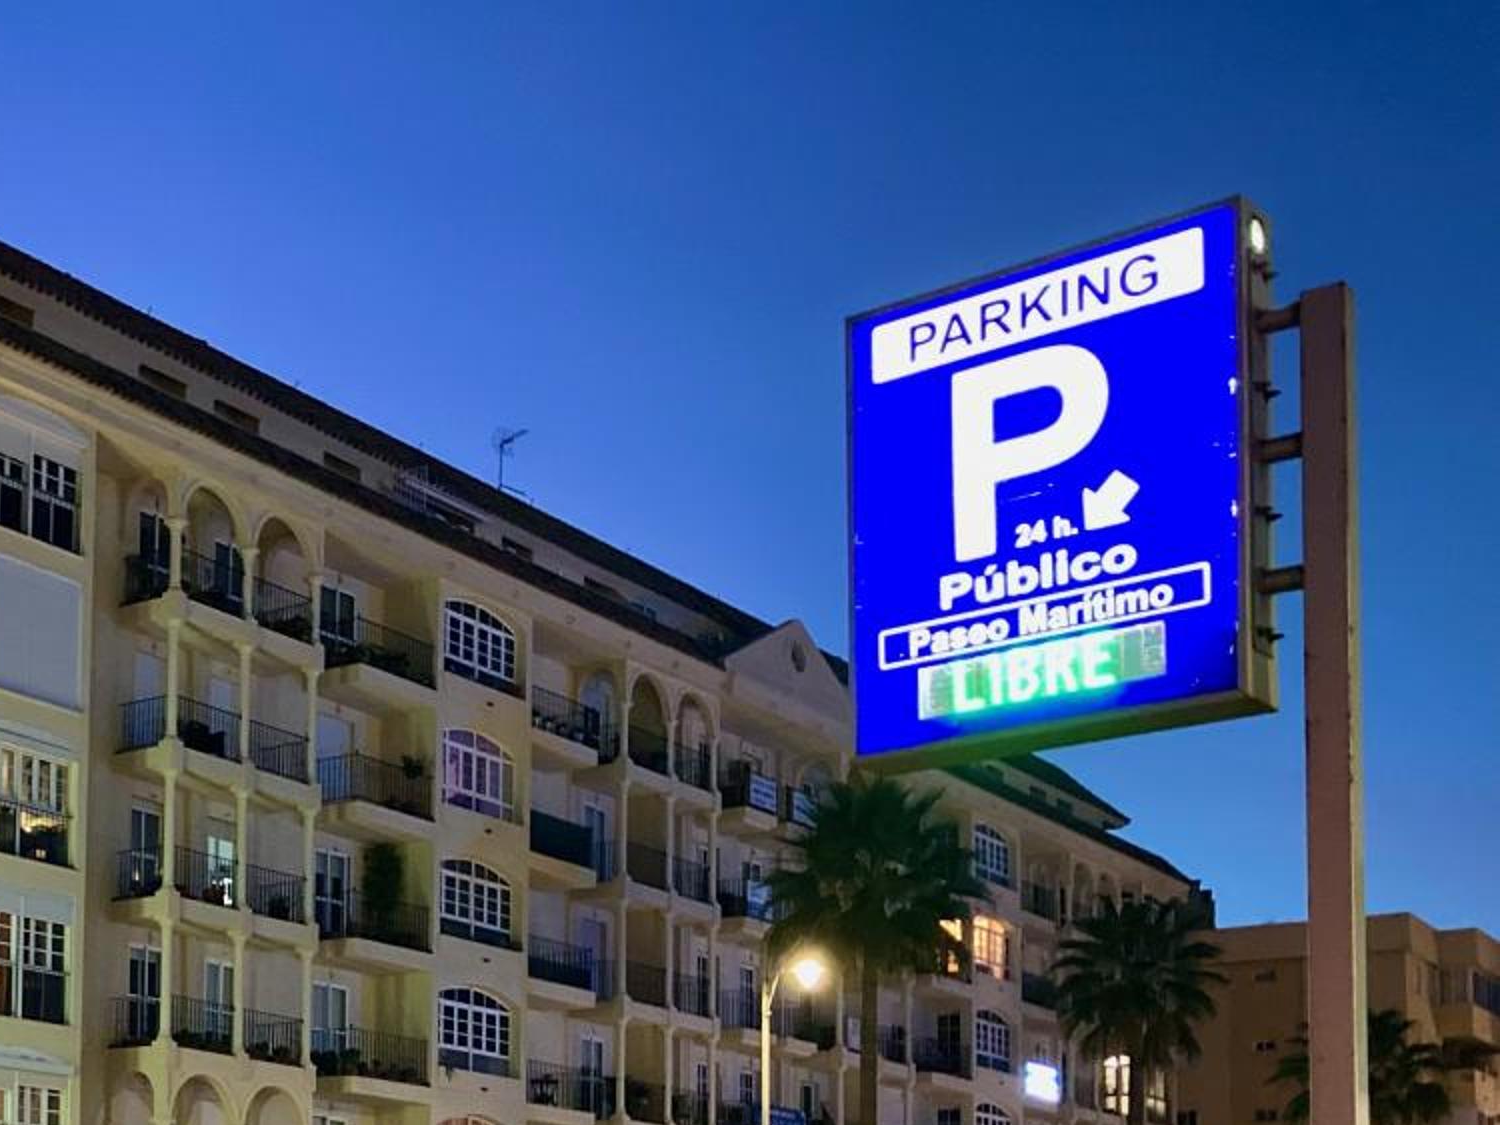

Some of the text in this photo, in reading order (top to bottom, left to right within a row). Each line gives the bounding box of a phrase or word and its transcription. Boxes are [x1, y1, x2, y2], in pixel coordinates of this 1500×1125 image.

[909, 254, 1159, 362] PARKING
[951, 343, 1110, 563] P
[1014, 516, 1079, 548] 24 h.
[939, 543, 1137, 611] Público
[909, 583, 1174, 659] Paseo Marítimo
[951, 634, 1117, 713] LIBRE
